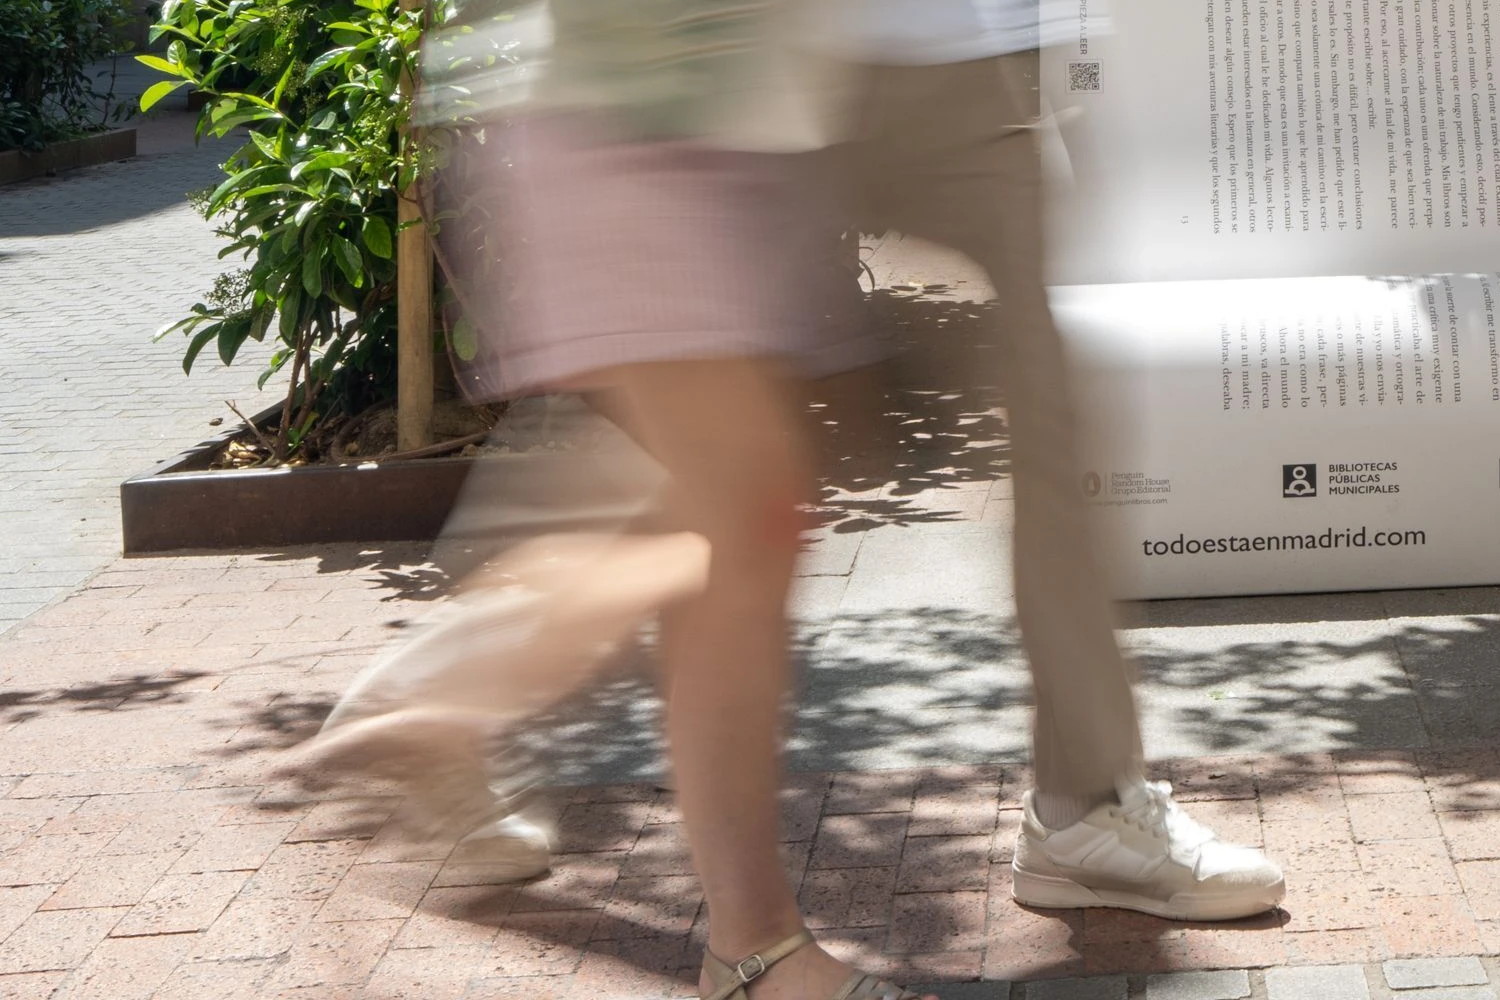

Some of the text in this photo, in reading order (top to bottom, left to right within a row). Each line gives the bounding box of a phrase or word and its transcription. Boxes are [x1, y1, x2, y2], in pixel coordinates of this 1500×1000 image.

[1379, 0, 1388, 16] Por
[1395, 5, 1404, 26] gran
[1080, 33, 1088, 55] LEER
[1364, 27, 1373, 60] escribir
[1382, 39, 1391, 47] al
[1398, 28, 1408, 66] cuidado,
[1415, 14, 1425, 74] contribución;
[1433, 25, 1441, 49] sobre
[1467, 32, 1474, 44] en
[1481, 12, 1493, 70] experiencias,
[1434, 51, 1443, 59] la
[1447, 30, 1458, 73] proyectos
[1468, 46, 1477, 55] el
[1365, 62, 1374, 95] sobre...
[1382, 50, 1390, 95] acercarme
[1434, 61, 1444, 105] naturaleza
[1450, 75, 1459, 91] que
[1469, 57, 1479, 90] mundo.
[1487, 72, 1493, 81] es
[1401, 86, 1410, 94] la
[1418, 75, 1427, 95] cada
[1488, 83, 1496, 91] el
[1384, 97, 1394, 105] al
[1437, 106, 1446, 117] de
[1452, 94, 1461, 119] tengo
[1488, 93, 1497, 114] lente
[1367, 97, 1377, 130] escribir.
[1385, 108, 1395, 127] final
[1400, 95, 1410, 137] esperanza
[1420, 115, 1427, 124] es
[1472, 93, 1484, 151] Considerando
[1387, 129, 1396, 139] de
[1438, 119, 1447, 130] mi
[1491, 123, 1500, 146] través
[1387, 142, 1397, 153] mi
[1405, 137, 1414, 148] de
[1438, 131, 1449, 163] trabajo.
[1453, 120, 1466, 168] pendientes
[1388, 155, 1397, 176] vida,
[1403, 150, 1412, 167] que
[1423, 142, 1433, 177] ofrenda
[1442, 165, 1451, 181] Mis
[1390, 179, 1396, 194] me
[1408, 185, 1416, 205] bien
[1422, 178, 1431, 196] que
[1443, 182, 1452, 209] libros
[1478, 176, 1487, 205] decidí
[1458, 177, 1468, 219] empezar
[1388, 197, 1398, 229] parece
[1409, 208, 1418, 229] reci-
[1423, 198, 1433, 228] prepa-
[1476, 207, 1486, 227] pos-
[1241, 354, 1251, 367] mi
[1337, 342, 1346, 362] más
[1429, 306, 1443, 403] crítica muy exigente
[1487, 314, 1499, 401] me transformo en
[1298, 329, 1304, 341] no
[1301, 397, 1310, 408] lo
[1356, 333, 1368, 406] de nuestras vi-
[1223, 367, 1233, 410] deseaba
[1242, 370, 1252, 409] madre;
[1335, 365, 1348, 406] páginas
[1112, 472, 1144, 481] Penguin
[1329, 462, 1398, 473] BIBLIOTECAS
[1111, 478, 1169, 487] Random House
[1329, 473, 1381, 484] PÚBLICAS
[1111, 485, 1171, 496] Grupo Editorial
[1329, 485, 1400, 495] MUNICIPALES
[1142, 526, 1426, 556] todoestaenmadrid.com
